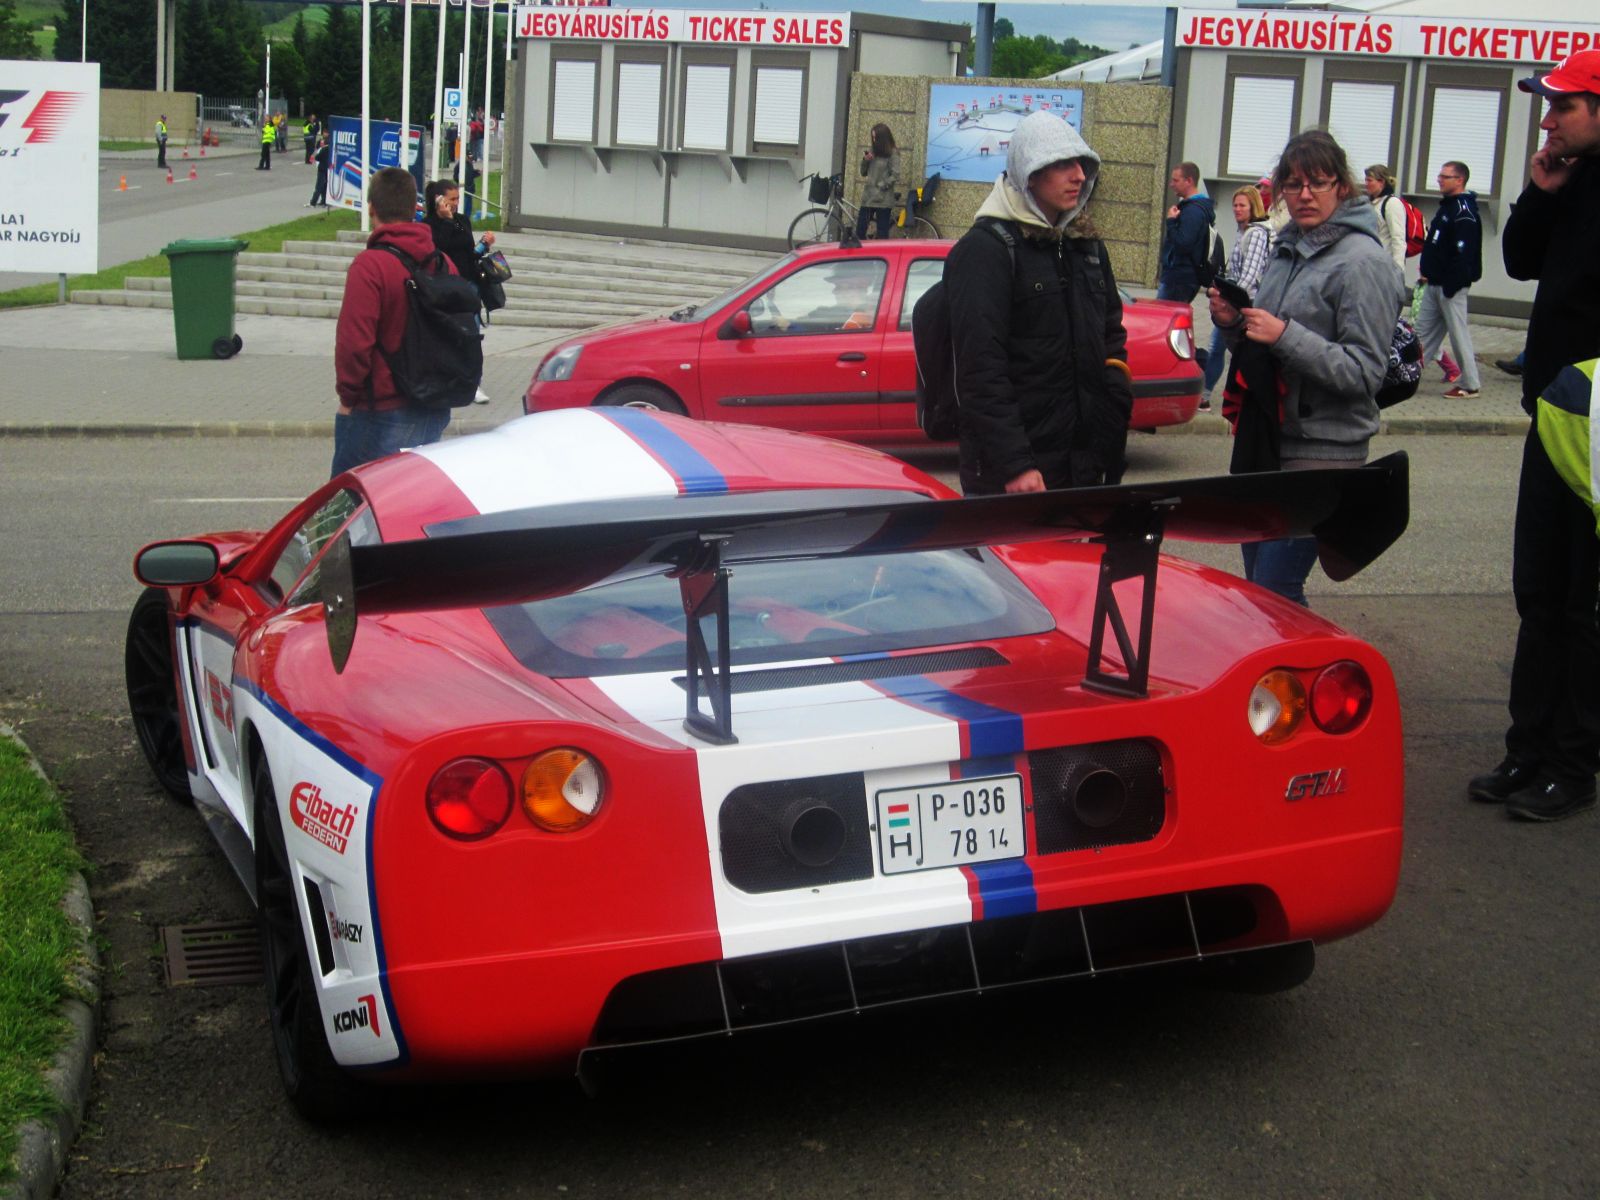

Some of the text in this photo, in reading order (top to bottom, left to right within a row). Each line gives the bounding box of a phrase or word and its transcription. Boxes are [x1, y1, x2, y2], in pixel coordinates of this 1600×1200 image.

[521, 9, 843, 45] JEGYÁRUSÍTÁS TICKET SALES
[1183, 12, 1600, 61] JEGYÁRUSÍTÁS TICKETVER
[18, 229, 81, 243] NAGYDÍJ
[290, 782, 355, 837] Eibach
[932, 787, 1006, 821] P-036
[302, 817, 344, 852] FEDERN
[890, 832, 912, 858] H
[950, 828, 1009, 857] 78 14
[333, 1005, 369, 1034] KONI
